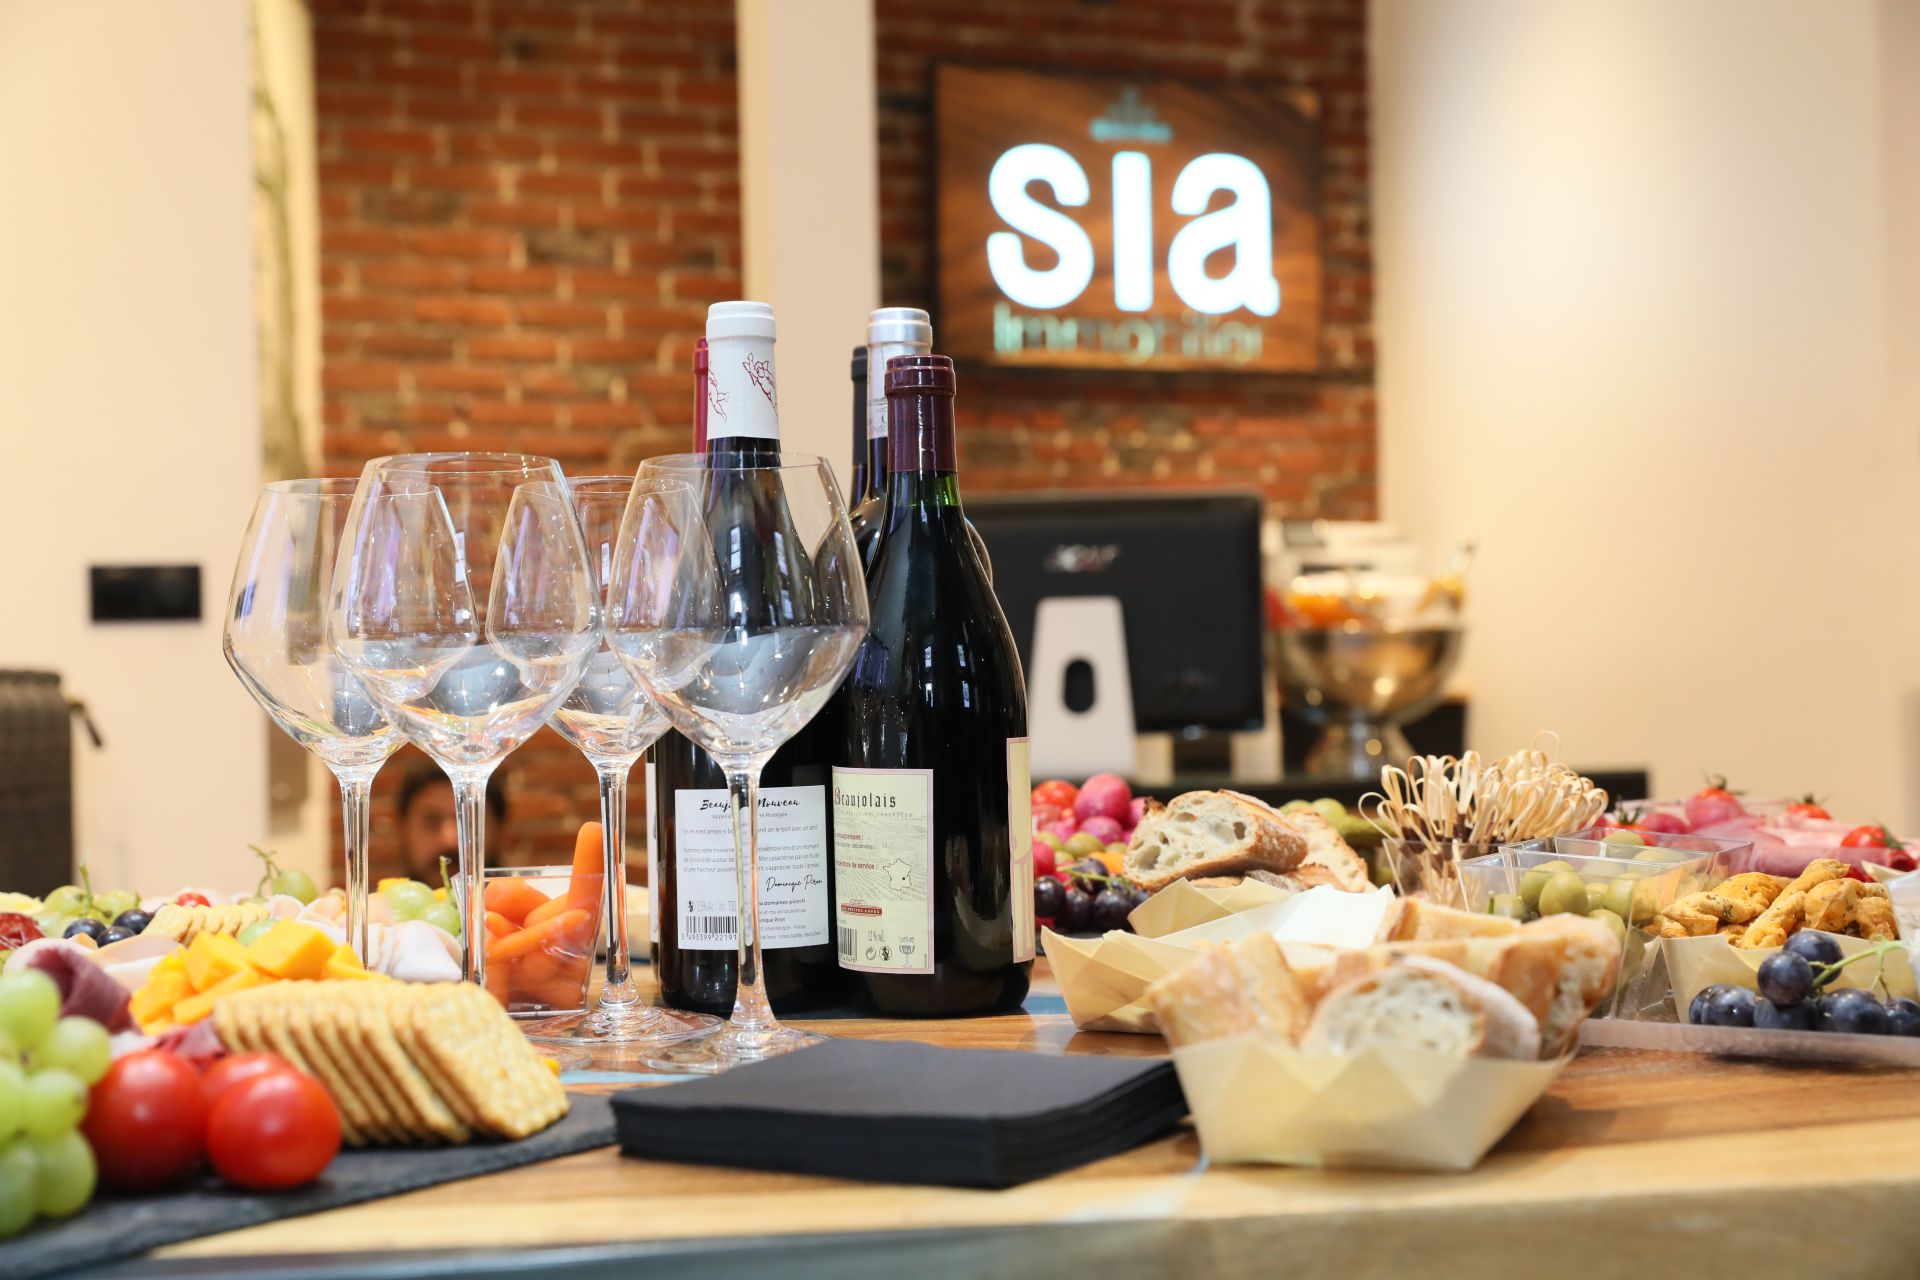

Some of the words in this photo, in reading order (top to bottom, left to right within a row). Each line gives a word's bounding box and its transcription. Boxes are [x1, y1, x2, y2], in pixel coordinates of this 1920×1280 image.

[700, 799, 731, 812] Beauj
[757, 797, 800, 808] Nouveau
[834, 786, 896, 808] Beaujolais
